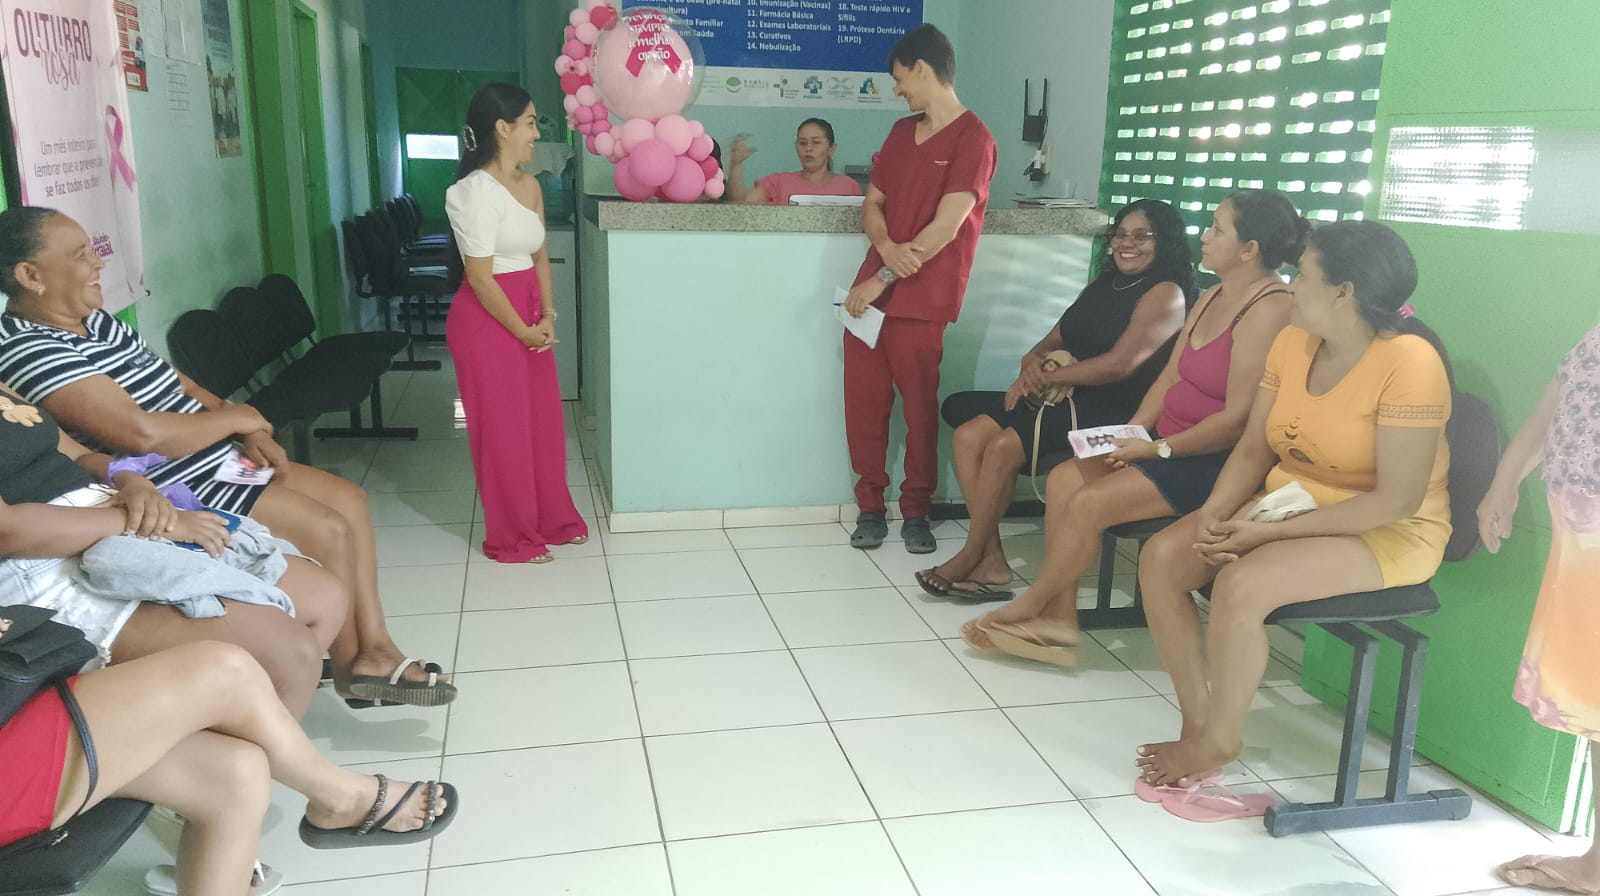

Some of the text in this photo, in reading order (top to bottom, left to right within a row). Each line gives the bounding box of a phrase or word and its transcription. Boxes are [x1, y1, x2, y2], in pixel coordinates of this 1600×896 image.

[800, 1, 831, 10] (Vacinas)
[869, 5, 891, 14] rápido
[746, 9, 814, 20] 11. Farmácia Básica
[695, 18, 724, 27] Familiar
[746, 20, 832, 31] 12. Exames Laboratoriais
[14, 8, 92, 62] OUTUBRO
[850, 25, 876, 34] Prótese
[876, 26, 905, 35] Dentária
[746, 31, 792, 40] 13. Curativos
[746, 42, 801, 52] 14. Nebulização
[45, 185, 54, 198] se
[54, 180, 66, 196] faz
